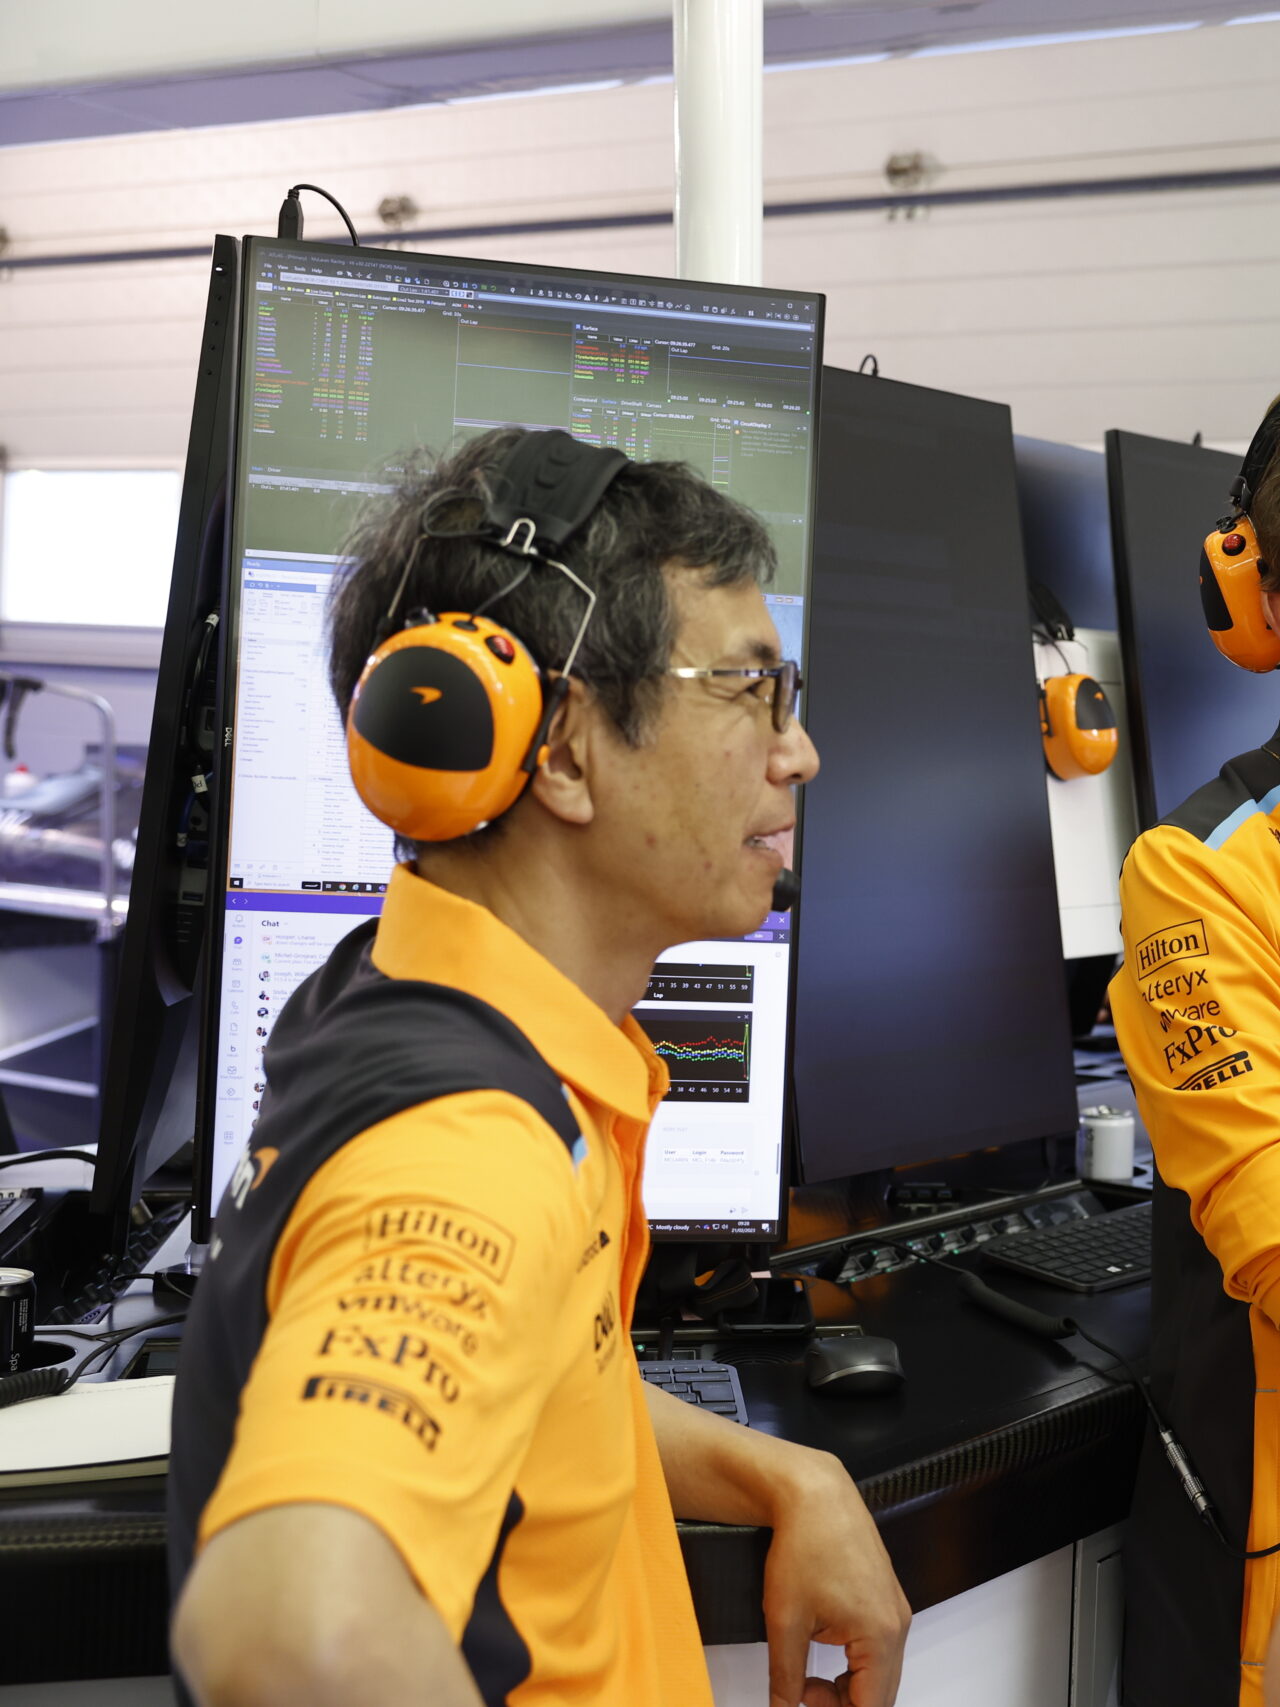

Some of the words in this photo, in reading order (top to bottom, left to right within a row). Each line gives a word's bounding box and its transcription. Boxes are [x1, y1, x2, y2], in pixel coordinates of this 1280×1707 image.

[262, 920, 280, 928] Chat
[1138, 934, 1200, 970] Hilton
[1163, 1024, 1238, 1074] FxPro
[376, 1210, 504, 1266] Hilton
[318, 1324, 461, 1404] FxPro
